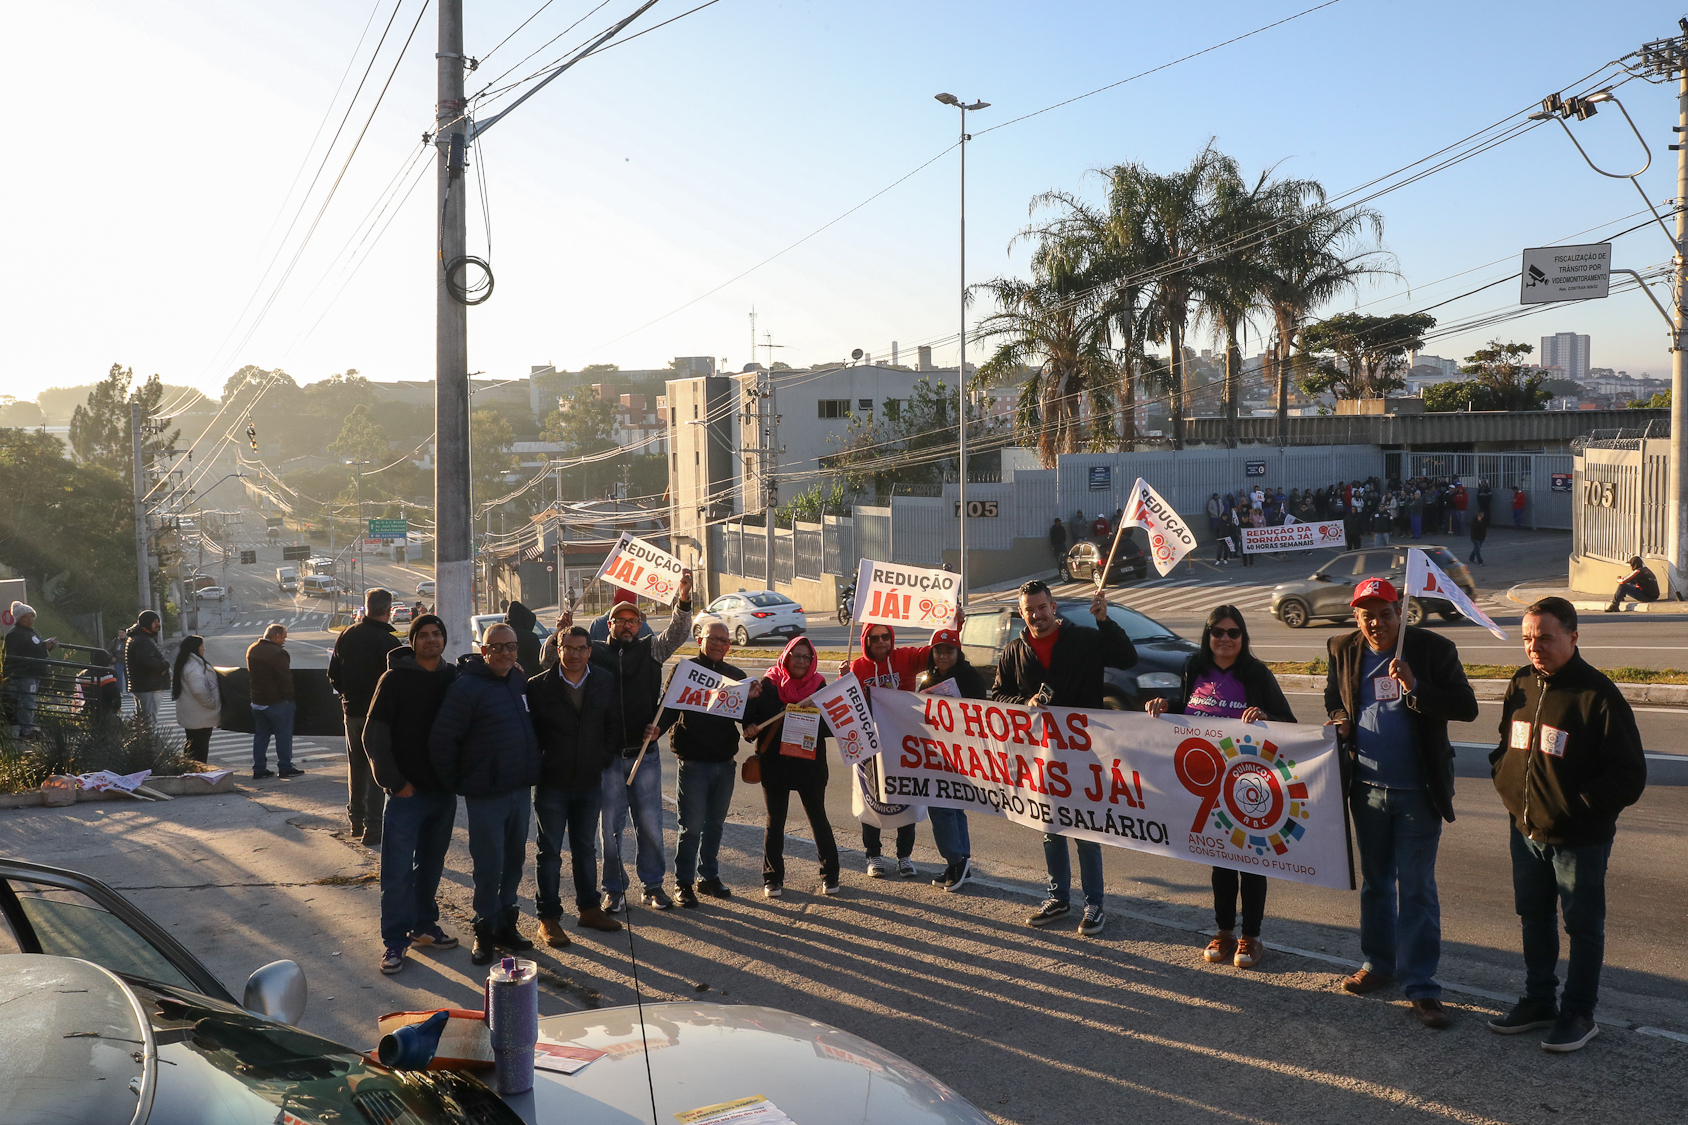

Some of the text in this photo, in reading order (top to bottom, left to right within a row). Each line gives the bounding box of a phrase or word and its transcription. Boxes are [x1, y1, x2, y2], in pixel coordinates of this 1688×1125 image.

[1554, 252, 1597, 263] FISCALIZAÇÃO
[1559, 263, 1602, 273] TRÂNSITO POR
[1552, 273, 1607, 284] VIDEOMONITORAMENTO
[1584, 480, 1614, 508] 705
[1141, 488, 1192, 545] REDUÇÃO
[1246, 525, 1312, 538] REDUÇÃO DA
[1246, 533, 1313, 544] JORNADA JÁ!
[619, 538, 682, 574] REDUÇÃO
[1255, 542, 1278, 550] HORAS
[1280, 540, 1314, 548] SEMANAIS
[605, 555, 645, 586] JÁ!
[873, 569, 954, 592] REDUÇÃO
[869, 588, 912, 620] JÁ!
[676, 686, 712, 707] JÁ!
[821, 695, 855, 730] JÁ!
[846, 685, 878, 750] REDUÇÃO
[924, 698, 1092, 752] 40 HORAS
[1174, 726, 1223, 738] RUMO AOS
[900, 734, 1072, 798] SEMANAIS
[1084, 758, 1146, 809] JÁ!
[1232, 762, 1272, 783] QUÍMICOS
[1173, 737, 1284, 834] 90
[885, 775, 1170, 845] SEM REDUÇÃO DE SALÁRIO!
[1188, 833, 1225, 850] ANOS
[1188, 845, 1317, 876] CONSTRUINDO O FUTURO
[697, 1109, 721, 1118] Marcha
